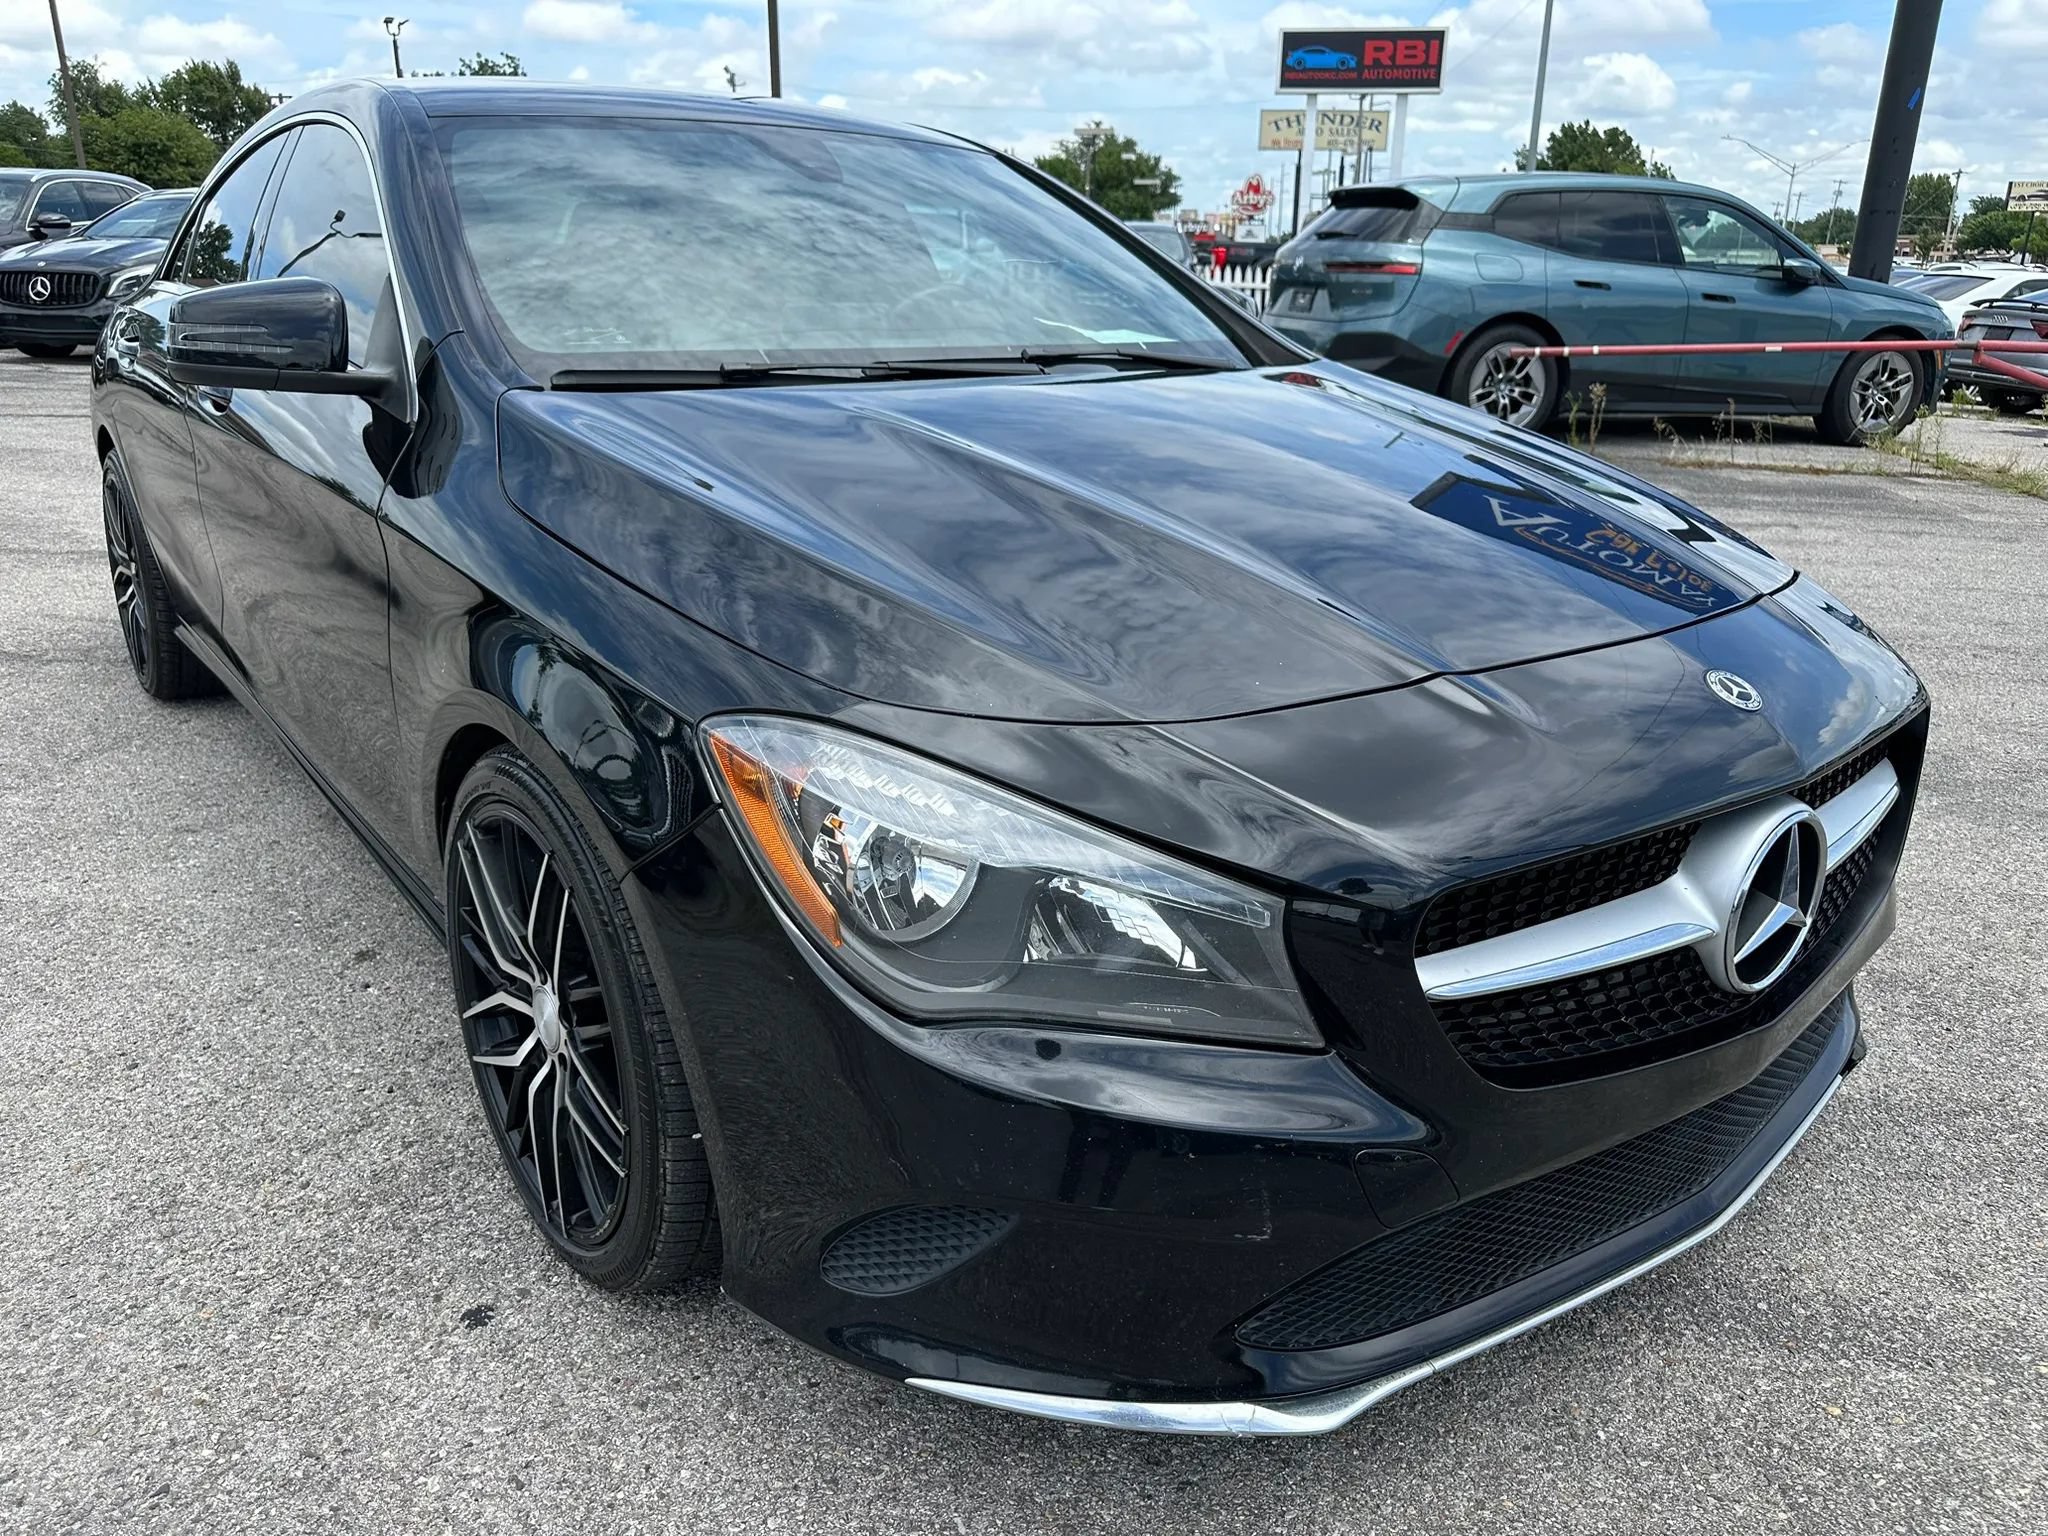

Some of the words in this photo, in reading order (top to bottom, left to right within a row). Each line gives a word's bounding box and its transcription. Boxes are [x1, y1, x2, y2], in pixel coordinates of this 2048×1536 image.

[1363, 40, 1440, 66] RBI
[1362, 68, 1438, 80] AUTOMOTIVE
[1268, 112, 1382, 133] THNDER
[1233, 190, 1273, 208] Arby's
